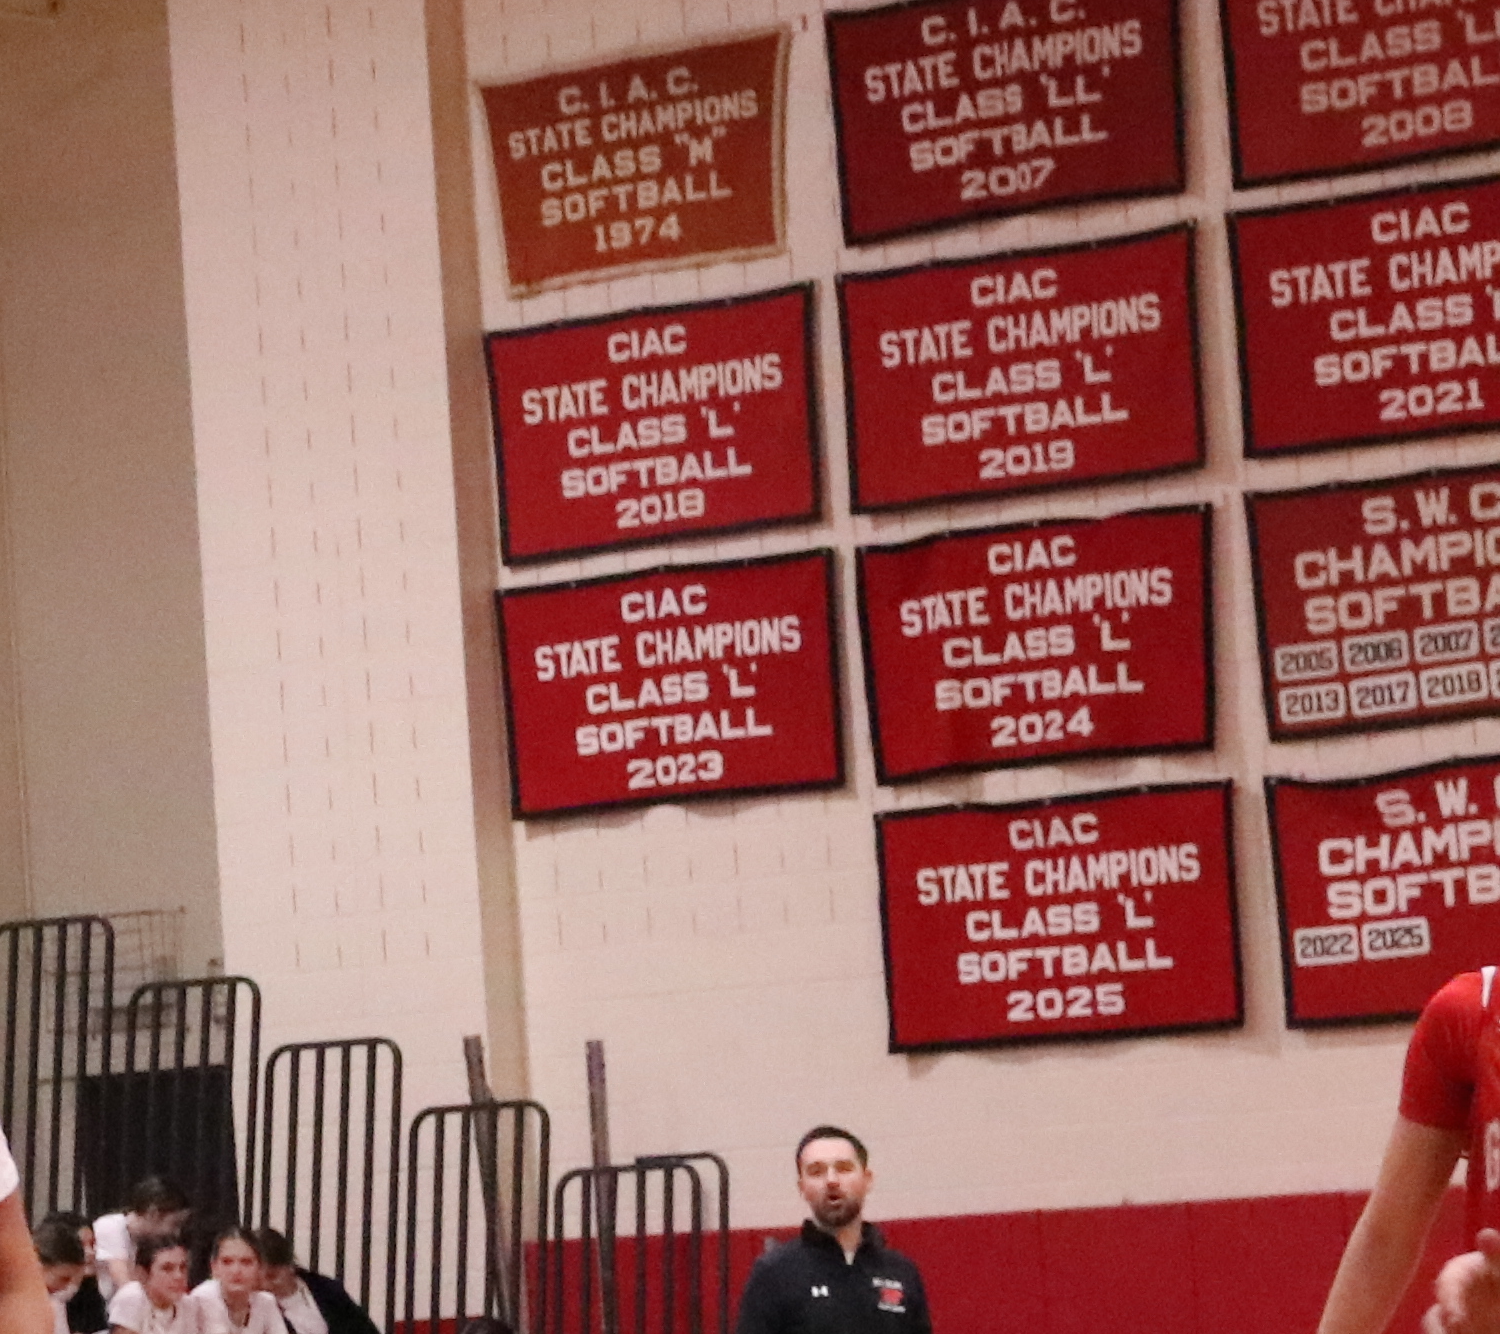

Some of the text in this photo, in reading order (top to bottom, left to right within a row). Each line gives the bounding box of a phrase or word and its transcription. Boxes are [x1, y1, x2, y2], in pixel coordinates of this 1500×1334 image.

[865, 21, 1142, 102] STATE CHAMPIONS
[1300, 20, 1441, 71] CLASS
[508, 90, 758, 160] STATE CHAMPIONS
[901, 83, 1022, 133] CLASS
[1362, 100, 1472, 147] 2008
[910, 114, 1107, 171] SOFTBALL
[541, 145, 661, 191] CLASS
[961, 158, 1055, 200] 2007
[541, 173, 731, 227] SOFTBALL
[595, 216, 681, 252] 1974
[1372, 202, 1469, 243] CIAC
[971, 269, 1056, 306] CIAC
[1270, 258, 1371, 306] STATE
[880, 295, 1160, 367] STATE CHAMPIONS
[1330, 294, 1473, 341] CLASS
[608, 325, 686, 362] CIAC
[522, 355, 782, 424] STATE CHAMPIONS
[932, 359, 1061, 403] CLASS
[1380, 379, 1484, 420] 2021
[568, 414, 687, 458] CLASS
[922, 393, 1128, 445] SOFTBALL
[561, 448, 752, 498] SOFTBALL
[980, 440, 1074, 479] 2019
[616, 489, 704, 528] 2018
[988, 536, 1076, 574] CIAC
[621, 585, 706, 622] CIAC
[901, 569, 1172, 636] STATE CHAMPIONS
[535, 616, 801, 681] STATE CHAMPIONS
[943, 625, 1075, 667] CLASS
[586, 671, 709, 714] CLASS
[935, 663, 1143, 710] SOFTBALL
[1285, 689, 1340, 715] 2013
[1356, 682, 1411, 709] 2017
[576, 709, 772, 755] SOFTBALL
[991, 707, 1093, 747] 2024
[627, 751, 723, 789] 2023
[1009, 814, 1098, 850] CIAC
[917, 844, 1200, 904] STATE CHAMPIONS
[966, 902, 1100, 941] CLASS
[958, 940, 1173, 983] SOFTBALL
[1300, 933, 1353, 959] 2022
[1007, 984, 1124, 1021] 2025
